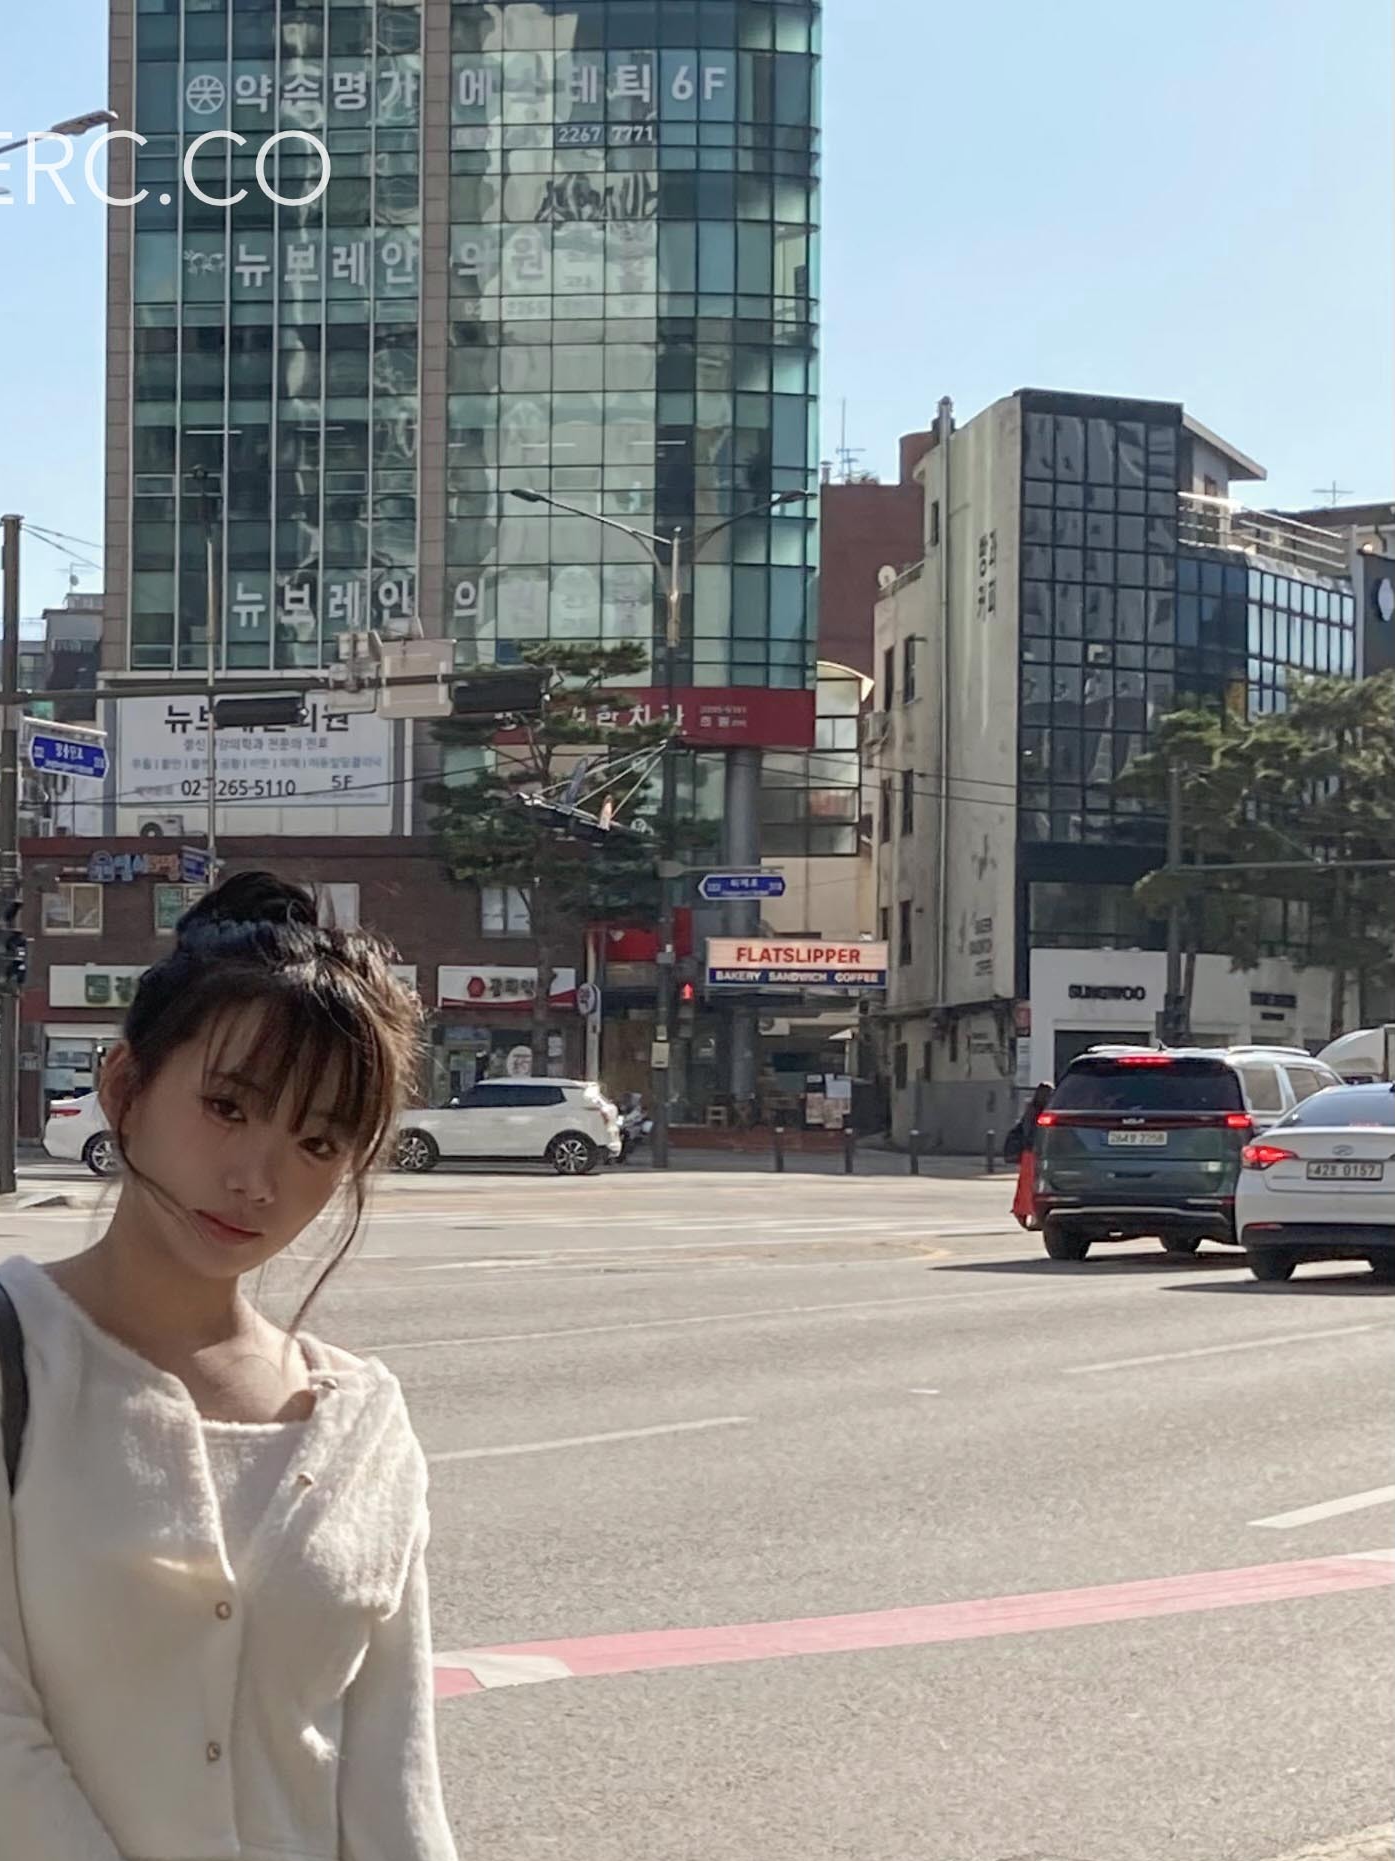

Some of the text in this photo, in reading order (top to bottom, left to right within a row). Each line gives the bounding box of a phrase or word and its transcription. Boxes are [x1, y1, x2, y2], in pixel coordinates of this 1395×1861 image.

[454, 64, 651, 107] 에테틱
[558, 125, 653, 144] 2267 7771
[184, 737, 264, 752] 정신강의학과
[181, 779, 297, 797] 02-265-5110
[736, 946, 861, 964] FLATSLIPPER
[715, 970, 879, 983] BAKERY SANDWICH COFFEE
[1343, 1164, 1376, 1177] 0157
